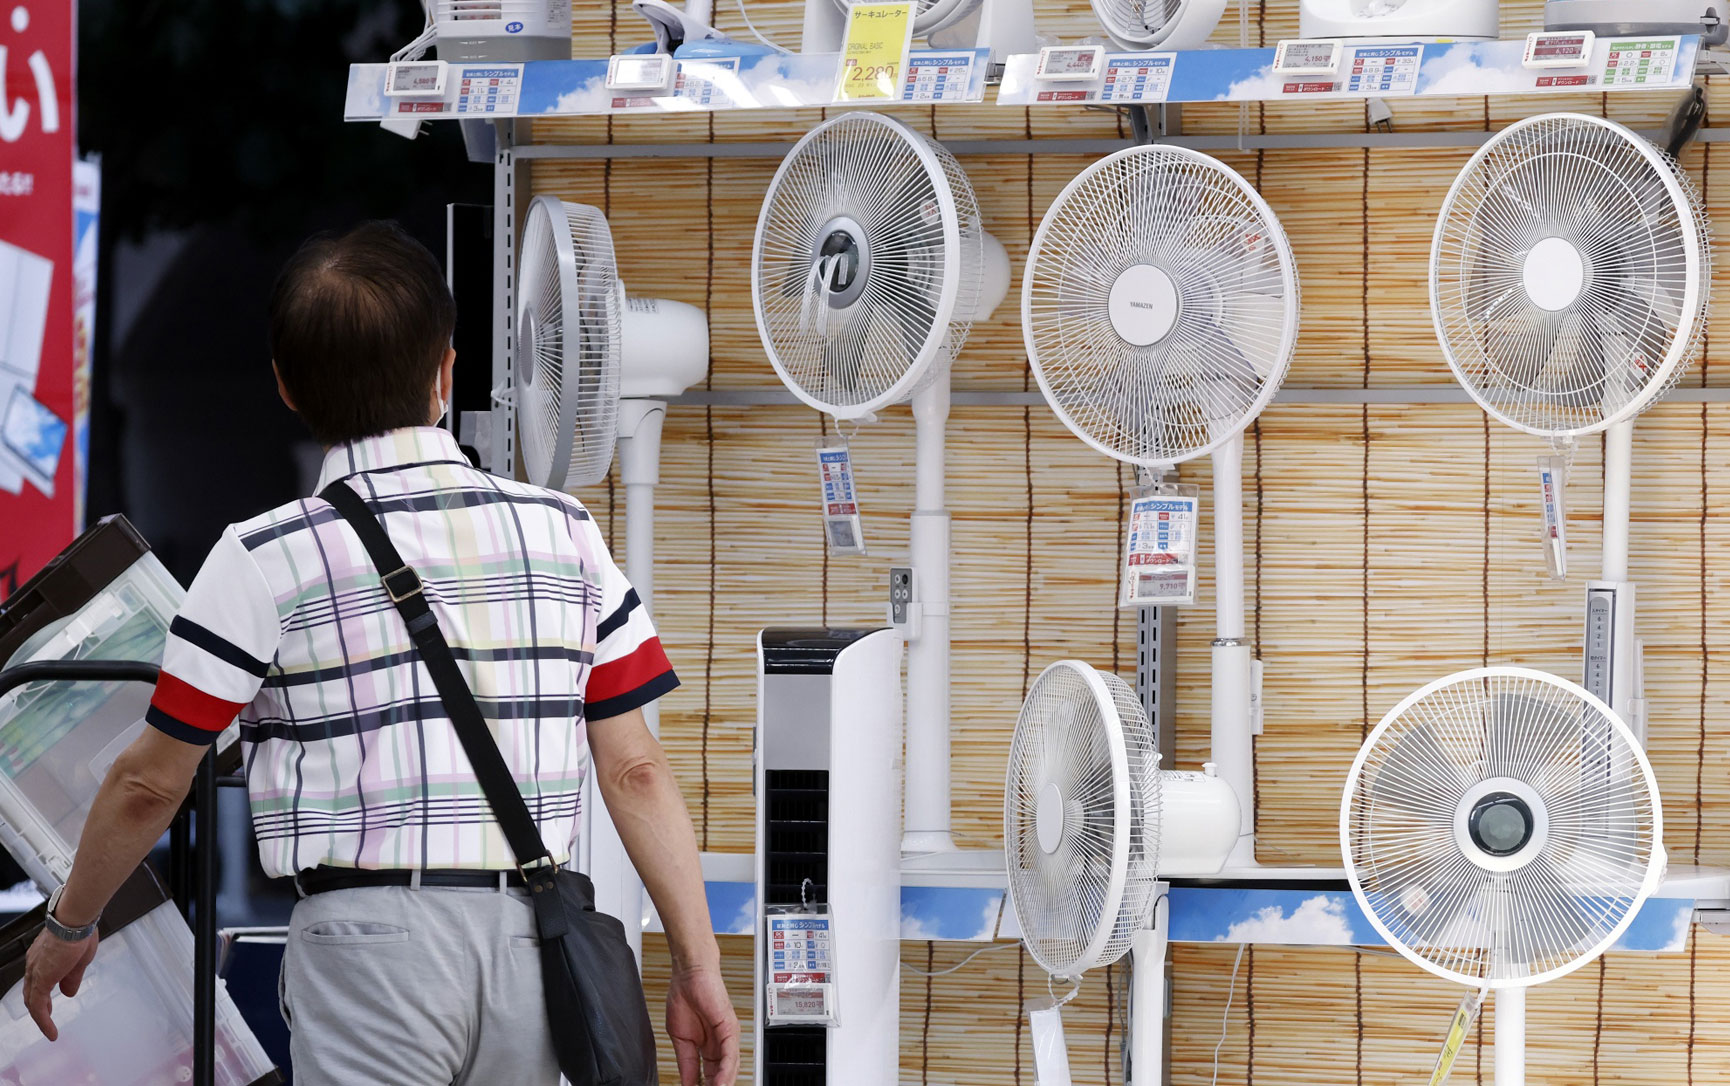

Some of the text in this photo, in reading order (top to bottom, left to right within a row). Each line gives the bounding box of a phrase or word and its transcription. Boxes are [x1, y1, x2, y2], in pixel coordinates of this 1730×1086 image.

[854, 10, 908, 19] サーキュレーター
[852, 65, 894, 82] 2,280
[1130, 301, 1153, 310] YAMAZEN
